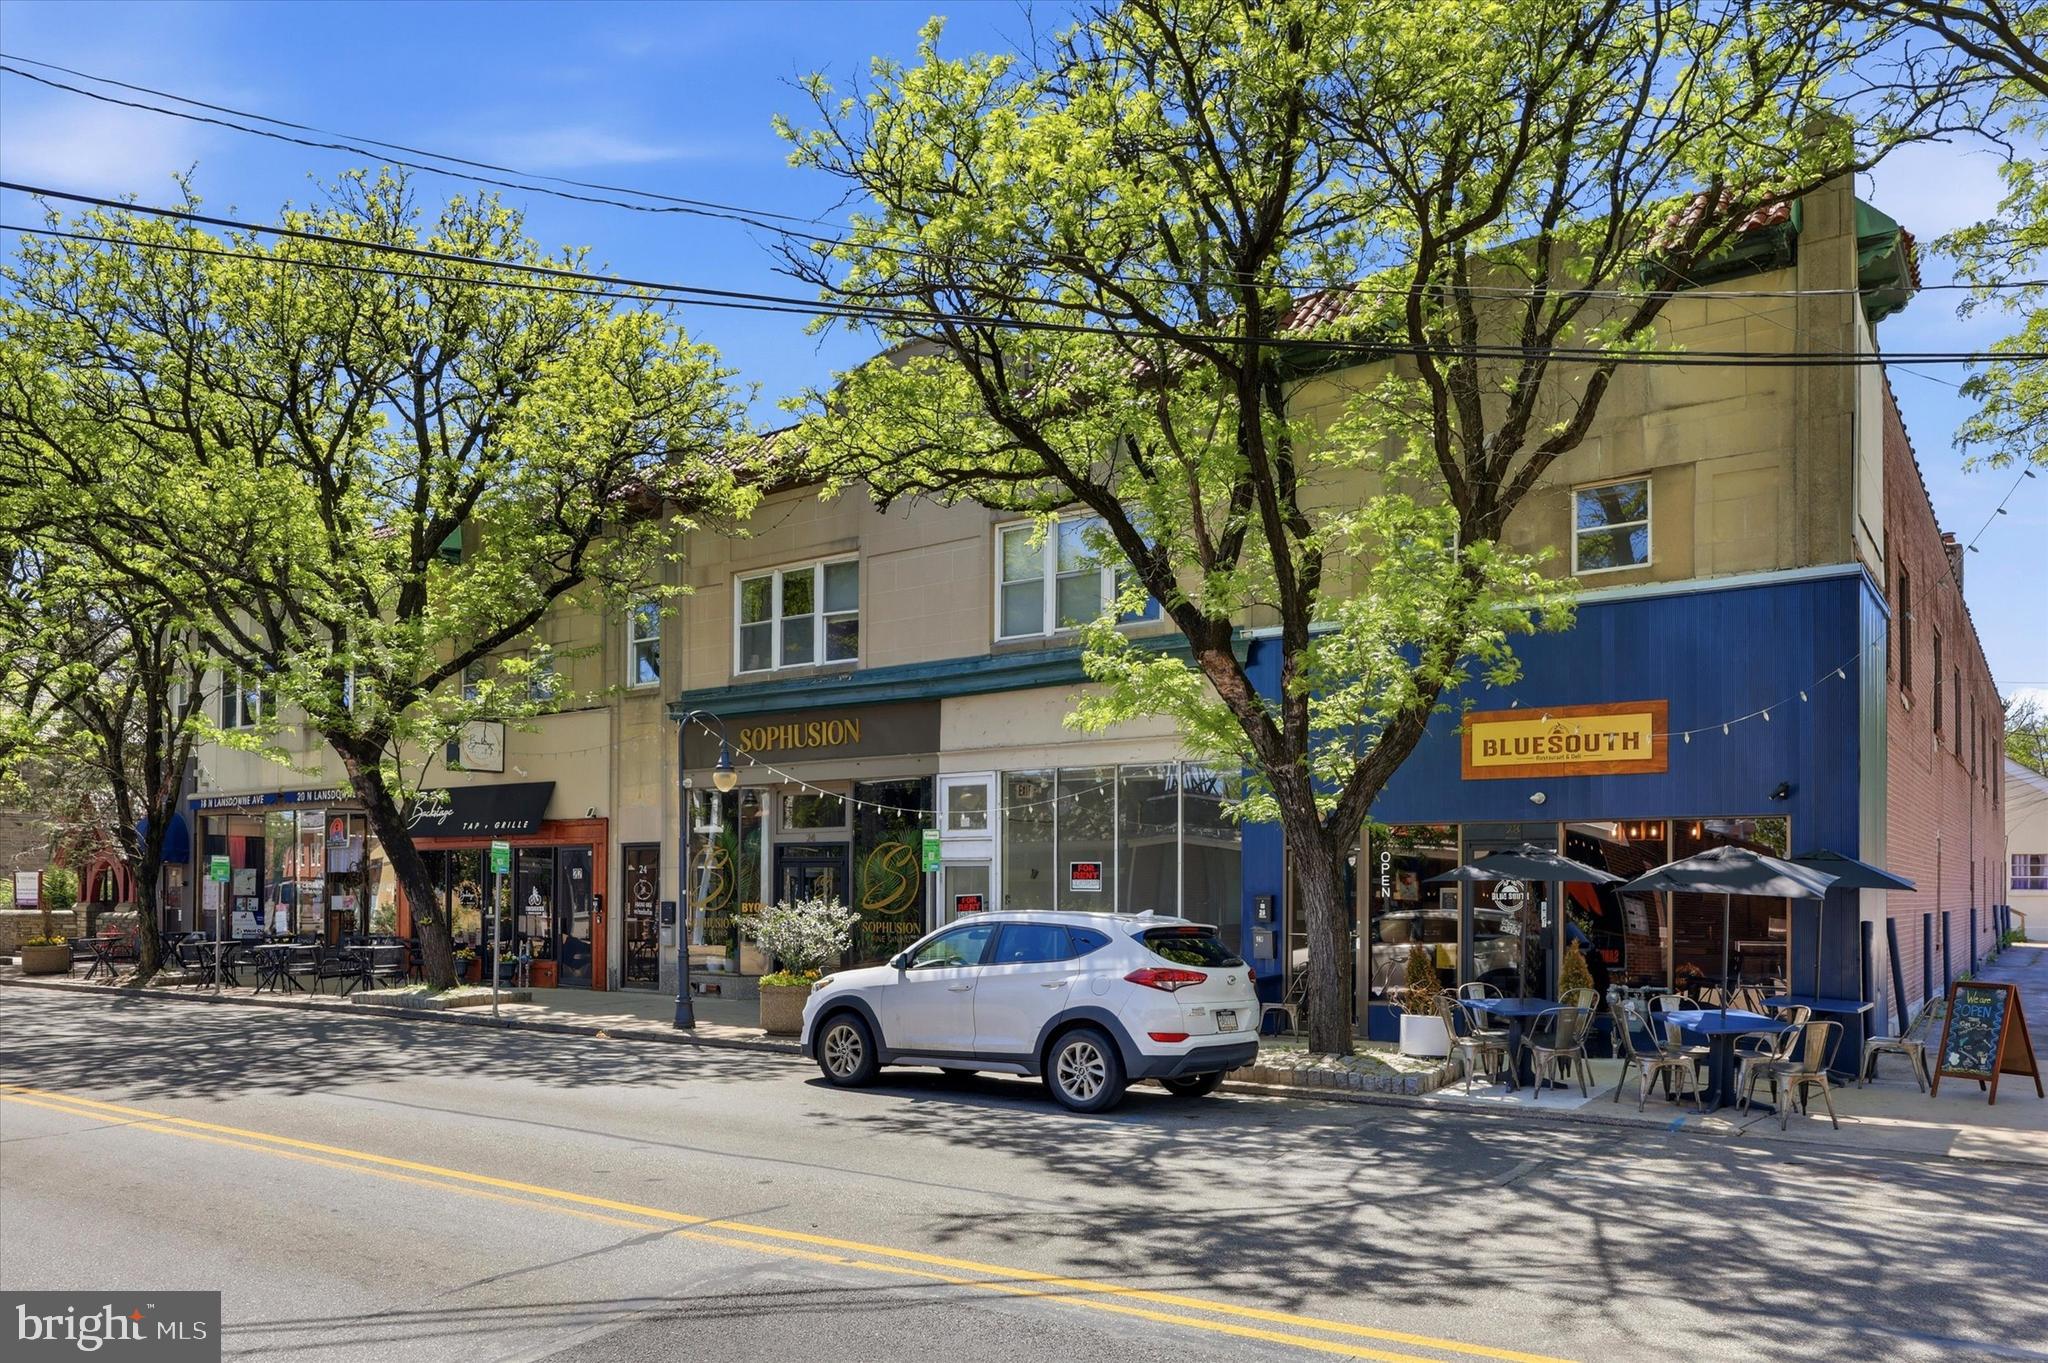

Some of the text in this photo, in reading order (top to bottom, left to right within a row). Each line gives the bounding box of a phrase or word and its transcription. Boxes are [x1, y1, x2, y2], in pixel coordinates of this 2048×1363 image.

[740, 719, 860, 753] SOPHUSION
[1483, 731, 1640, 757] BLUESOUTH
[208, 799, 213, 808] N
[214, 796, 251, 807] LANSDOWNE
[252, 795, 264, 804] AVE
[297, 792, 305, 801] 20
[307, 791, 312, 800] N
[407, 791, 455, 830] Backstage
[463, 820, 529, 830] TAP GRILLE
[639, 865, 648, 874] 24
[1077, 864, 1095, 872] FOR
[1380, 851, 1391, 897] OPEN
[1072, 871, 1099, 879] RENT
[962, 896, 978, 904] FOR
[958, 904, 981, 912] RENT
[862, 921, 921, 934] SOPHUSION
[1967, 990, 1979, 1004] We
[1961, 1004, 1992, 1017] OPEN
